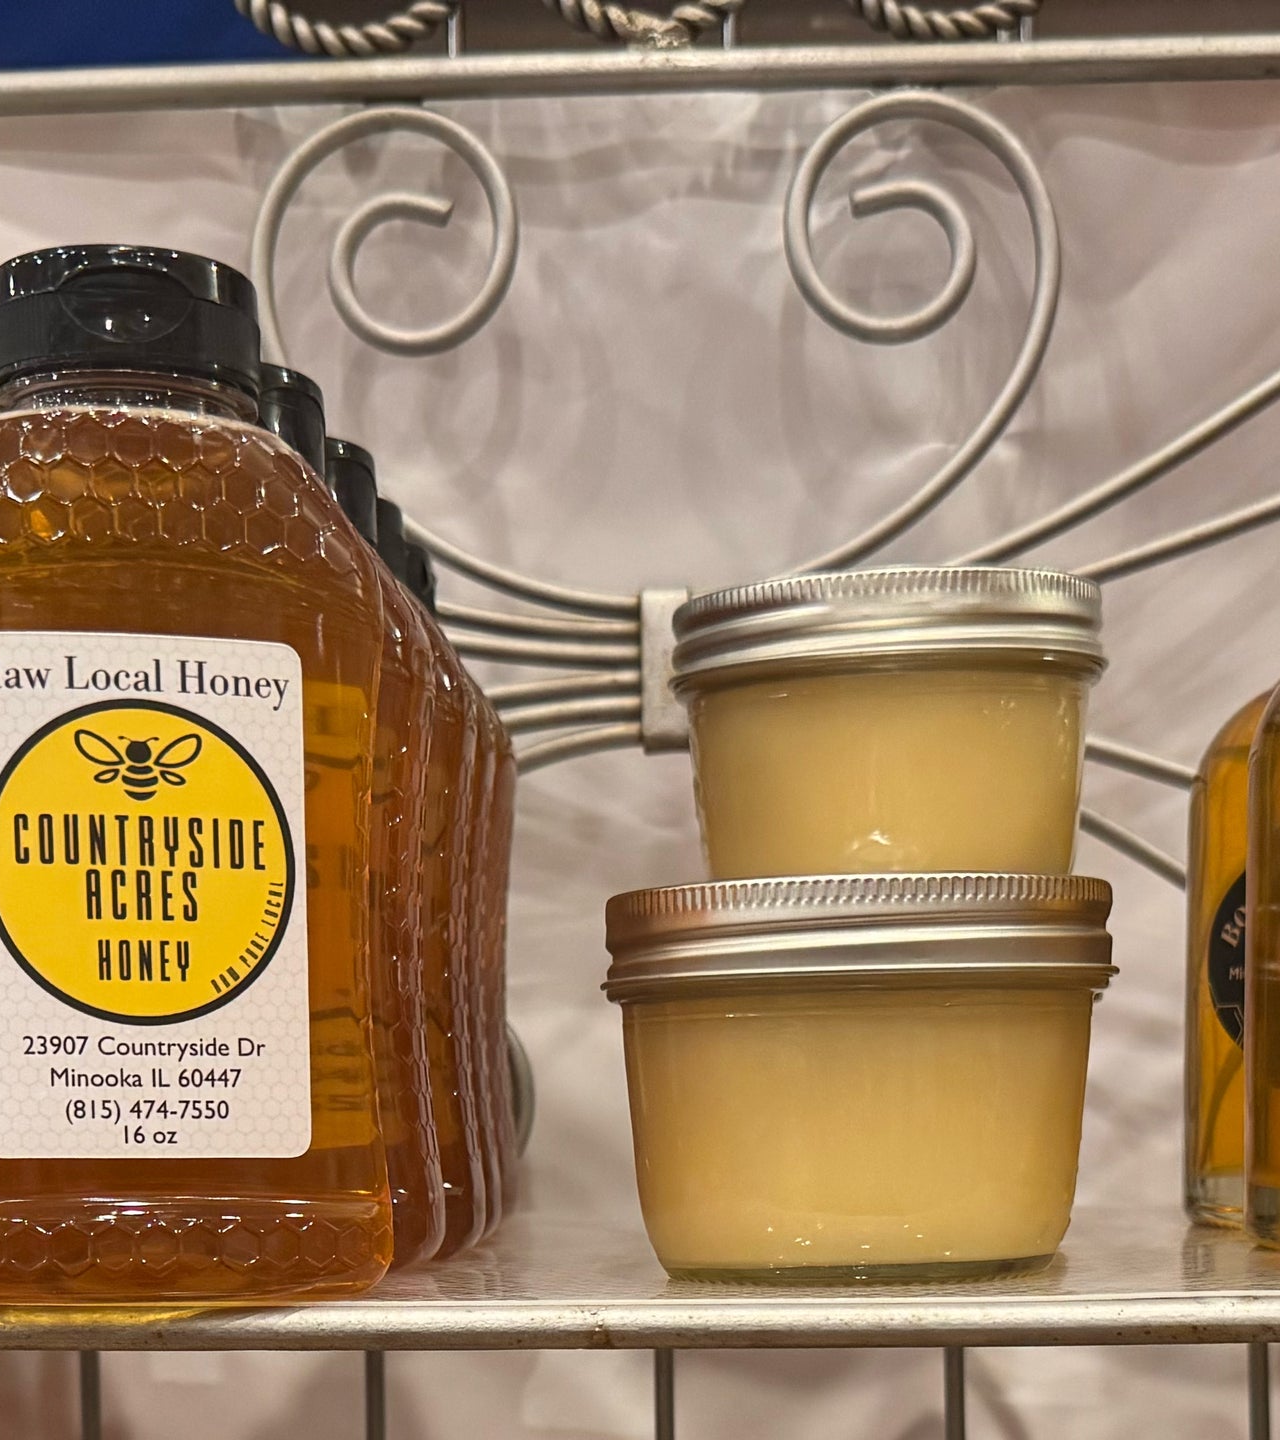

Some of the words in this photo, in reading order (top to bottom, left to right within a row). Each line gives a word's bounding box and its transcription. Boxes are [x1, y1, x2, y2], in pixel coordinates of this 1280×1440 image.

[64, 655, 162, 693] Local
[177, 660, 290, 711] Honey
[14, 813, 266, 871] COUNTRYSIDE
[86, 869, 199, 923] ACRES
[261, 882, 284, 928] LOCAL
[98, 939, 191, 983] HONEY
[23, 1036, 88, 1056] 23907
[97, 1036, 230, 1062] Countryside
[238, 1039, 266, 1058] Dr
[50, 1069, 143, 1089] Minooka
[152, 1069, 172, 1088] IL
[178, 1069, 242, 1089] 60447
[65, 1099, 121, 1125] (815)
[129, 1101, 230, 1120] 474-7550
[121, 1126, 146, 1145] 16
[153, 1129, 178, 1145] oz
